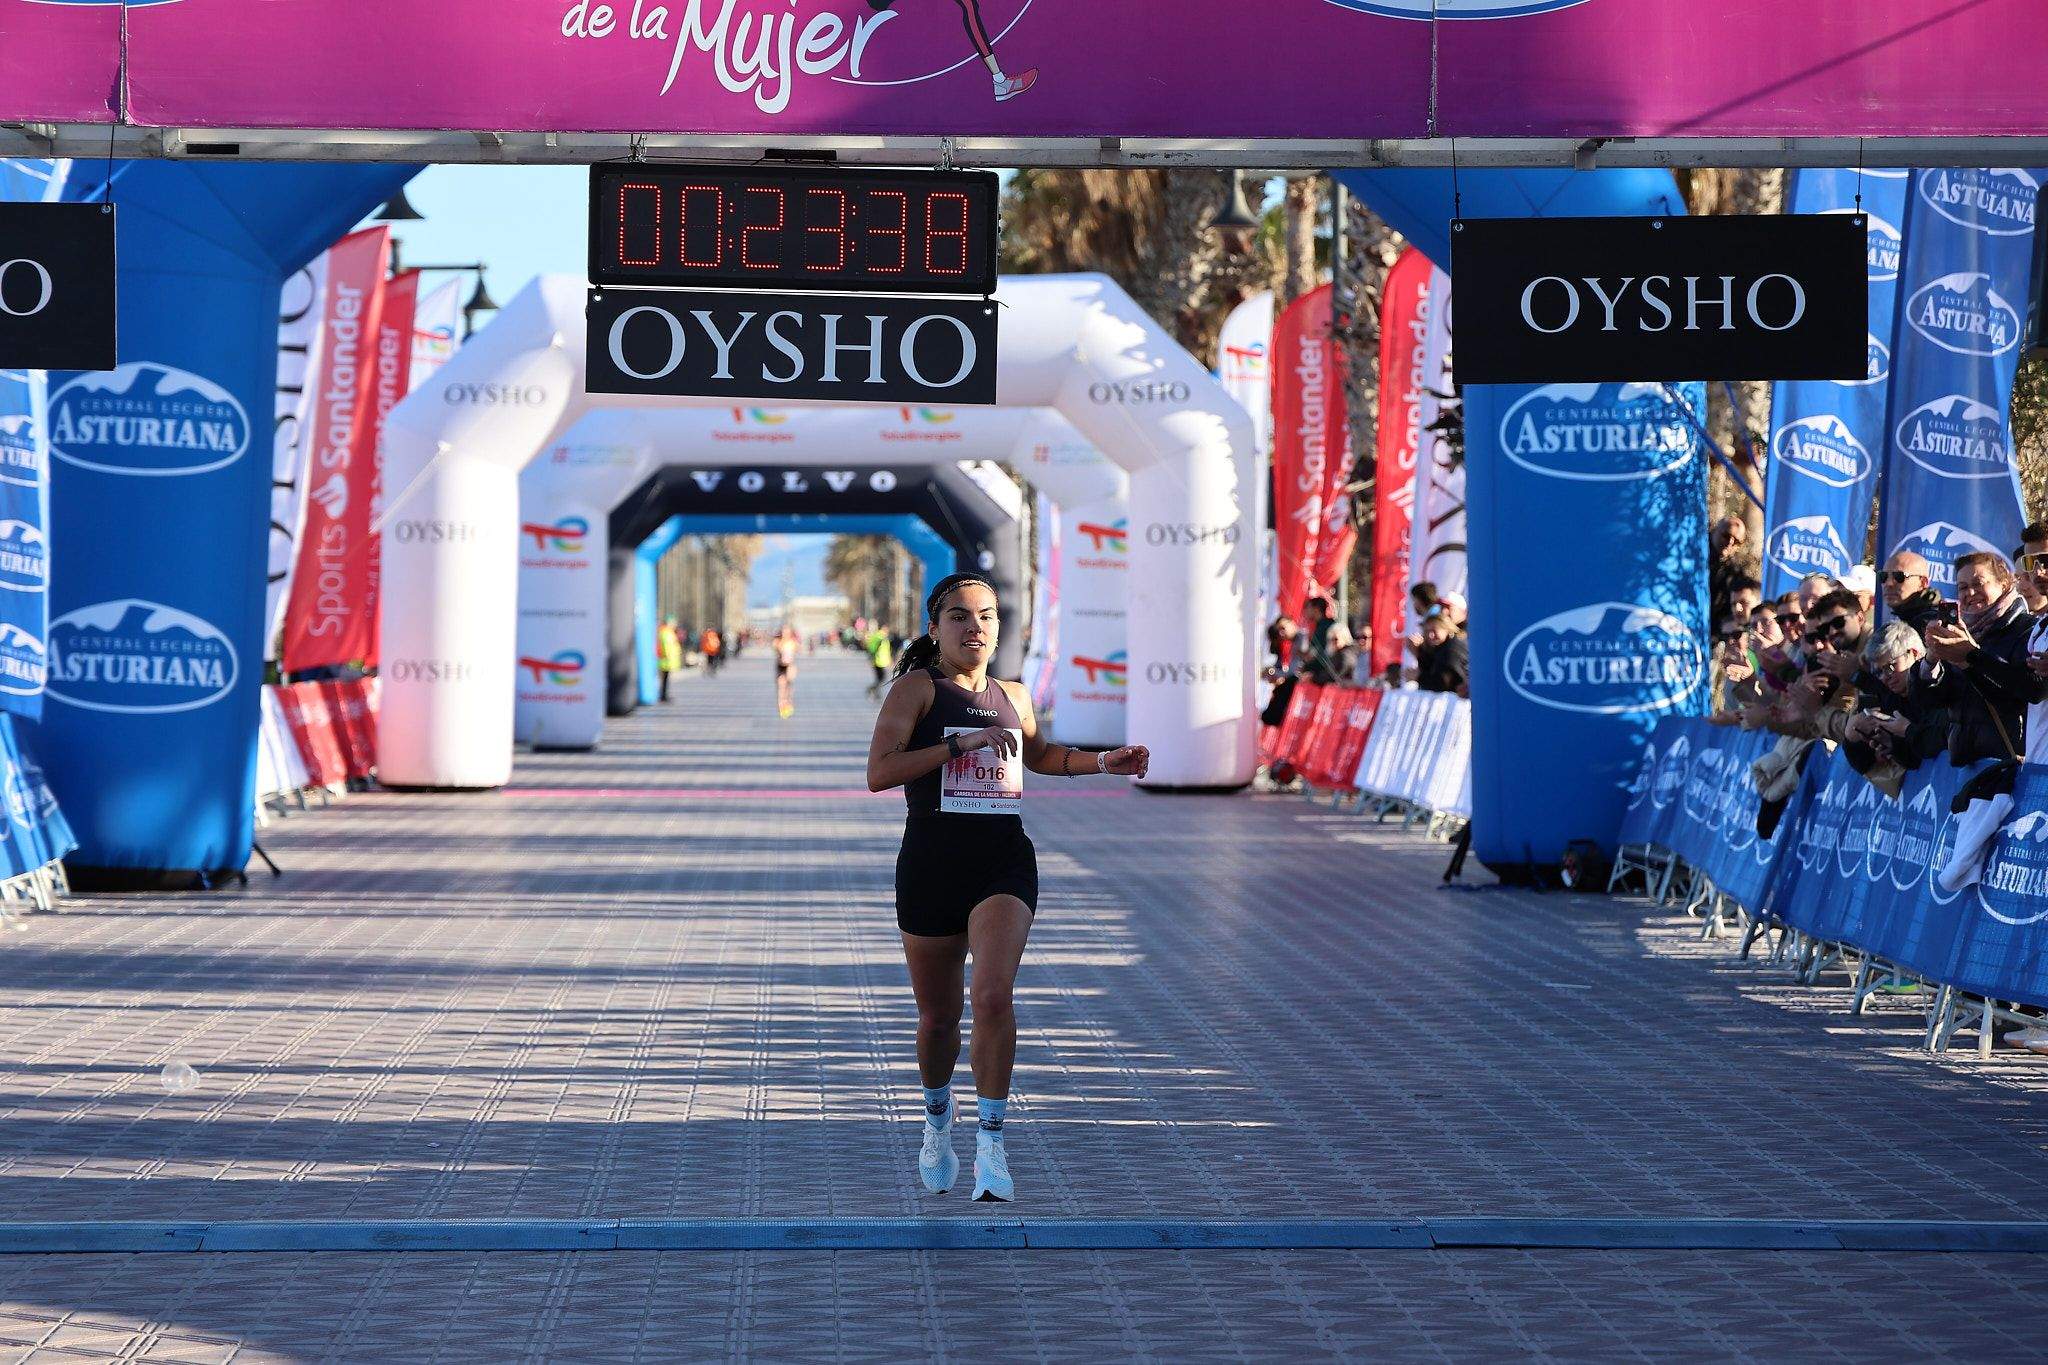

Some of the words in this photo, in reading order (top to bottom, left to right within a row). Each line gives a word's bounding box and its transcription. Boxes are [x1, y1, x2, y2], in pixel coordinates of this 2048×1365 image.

[561, 0, 617, 38] de
[630, 0, 669, 40] la
[659, 0, 899, 114] Mujer
[619, 184, 969, 274] 00:23:38
[1520, 273, 1806, 333] OYSHO
[608, 305, 978, 389] OYSHO
[321, 281, 363, 469] Santander
[444, 382, 547, 407] OYSHO
[1088, 381, 1191, 406] OYSHO
[80, 399, 154, 413] CENTRAL
[160, 401, 234, 418] LECHERA
[1295, 334, 1327, 493] Santander
[1545, 407, 1619, 420] CENTRAL
[52, 400, 238, 451] ASTURIANA
[1514, 411, 1694, 453] ASTURIANA
[1929, 420, 1959, 433] CENTRAL
[1908, 419, 2008, 464] ASTURIAN
[689, 470, 898, 494] VOLVO
[1145, 523, 1241, 547] OYSHO
[309, 523, 352, 637] Sports
[69, 636, 141, 650] CENTRAL
[150, 639, 221, 655] LECHERA
[1549, 639, 1621, 651] CENTRAL
[48, 638, 225, 688] ASTURIANA
[391, 659, 475, 683] OYSH
[1518, 643, 1696, 685] ASTURIANA
[966, 707, 998, 717] OYSHO
[975, 766, 1005, 781] 016
[952, 800, 981, 808] OYSHO
